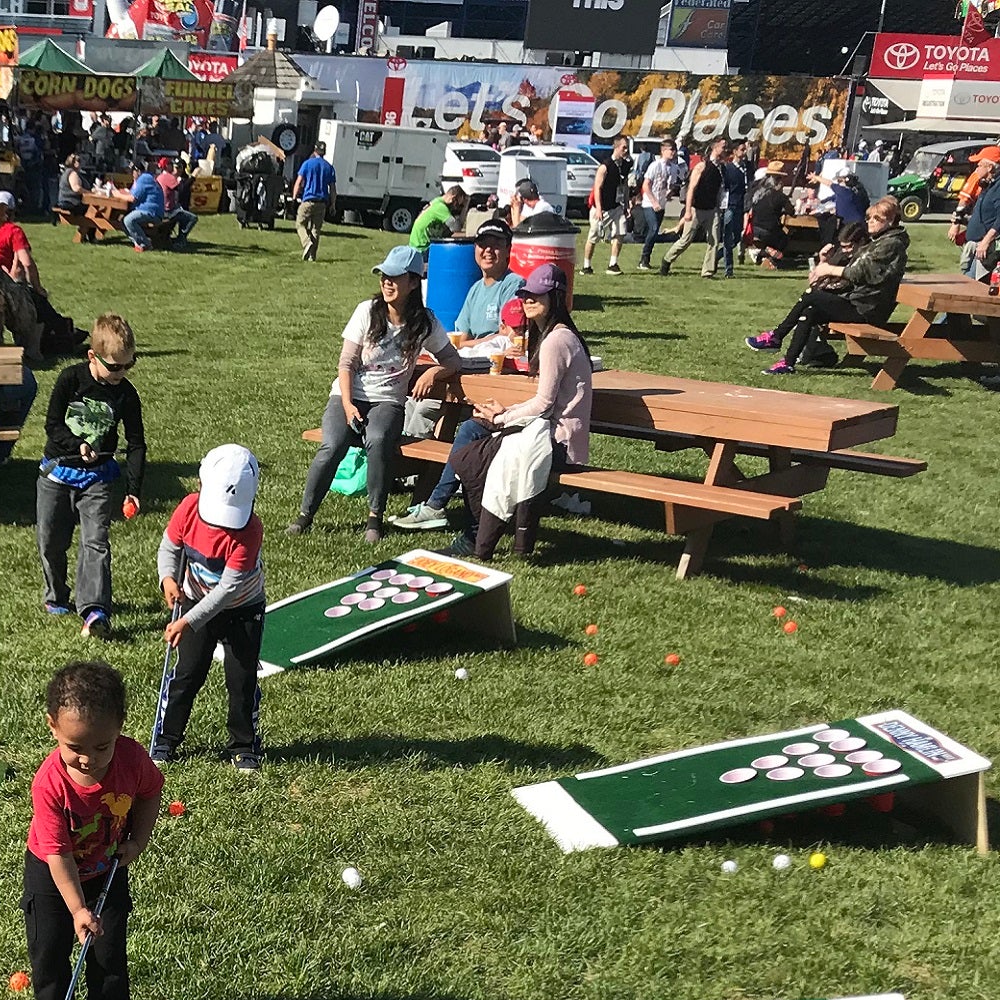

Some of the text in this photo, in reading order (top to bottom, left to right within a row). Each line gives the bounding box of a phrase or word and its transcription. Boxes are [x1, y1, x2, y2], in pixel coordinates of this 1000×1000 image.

[924, 45, 990, 61] TOYOTA
[187, 60, 230, 75] OYOTA
[923, 61, 989, 72] Let's Go Places
[22, 75, 77, 97] CORN
[83, 77, 135, 100] DOGS
[165, 80, 235, 99] FUNNEL
[169, 100, 229, 116] CAKES
[638, 88, 832, 146] Places
[360, 131, 374, 142] CAT
